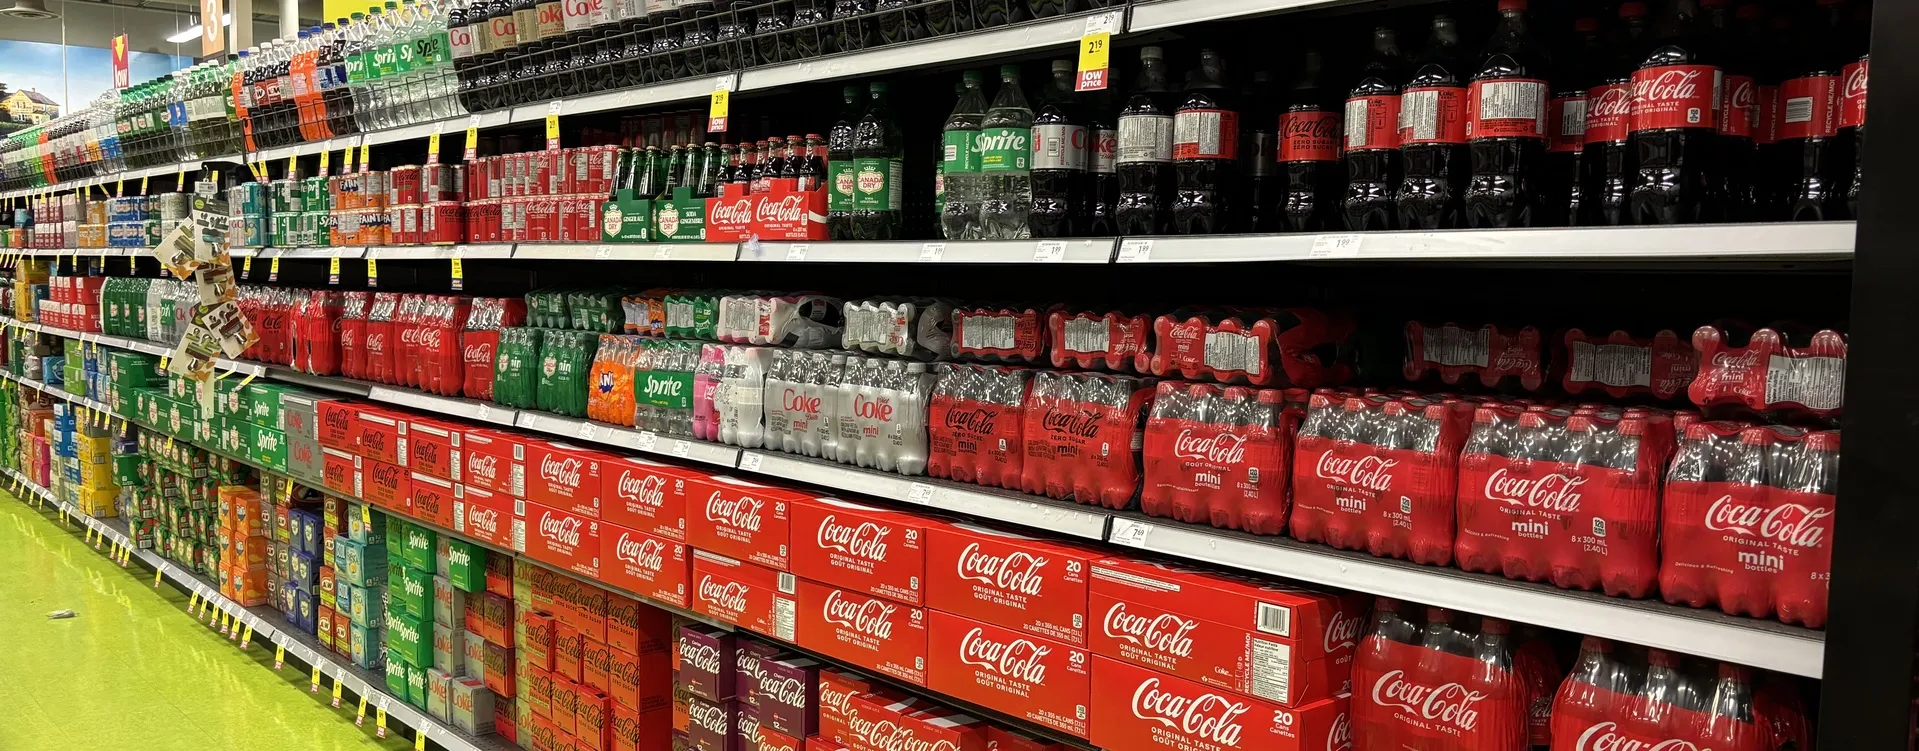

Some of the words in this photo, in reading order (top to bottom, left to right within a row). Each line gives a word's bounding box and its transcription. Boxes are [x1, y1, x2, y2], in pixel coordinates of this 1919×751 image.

[1080, 79, 1102, 90] price
[1082, 70, 1103, 81] low
[1828, 79, 1836, 105] ME/MOI
[711, 117, 725, 125] low
[1722, 103, 1730, 132] RECYCLE
[1825, 105, 1834, 134] RECYCLE
[710, 124, 724, 132] price
[971, 129, 1027, 156] Sprite
[755, 195, 804, 222] Coca-Cola
[604, 216, 622, 224] CANADA
[608, 223, 618, 231] DRY
[658, 216, 679, 224] CANADA
[663, 223, 674, 231] DRY
[643, 374, 682, 396] Sprite
[254, 400, 270, 417] Sprite
[782, 388, 822, 414] Coke
[854, 393, 893, 422] Coke
[945, 404, 1000, 435] Coca-Cola
[257, 429, 278, 452] Sprite
[1050, 434, 1067, 442] ZERO
[1068, 436, 1087, 446] SUGAR
[1174, 428, 1248, 464] Coca-Cola
[372, 457, 399, 490] Coca-Cola
[468, 451, 498, 479] Coca-Cola
[540, 453, 583, 488] Coca-Cola
[590, 461, 599, 471] 20
[1204, 462, 1232, 472] ORIGINAL
[1316, 449, 1401, 491] Coca-Cola
[675, 479, 684, 490] 20
[1195, 470, 1221, 485] mini
[617, 469, 667, 508] Coca-Cola
[1326, 483, 1357, 493] ORIGINAL
[1358, 488, 1377, 498] TASTE
[1485, 468, 1590, 512] Coca-Cola
[705, 490, 765, 533] Coca-Cola
[775, 501, 786, 512] 20
[1336, 495, 1367, 511] mini
[468, 504, 498, 533] Coca-Cola
[1391, 512, 1403, 520] 300
[1403, 513, 1412, 522] mL
[1499, 506, 1537, 516] ORIGINAL
[1538, 510, 1562, 521] TASTE
[1705, 494, 1835, 548] Coca-Cola
[540, 510, 583, 549] Coca-Cola
[589, 521, 599, 531] 20
[715, 524, 738, 535] ORIGINAL
[737, 529, 752, 539] TASTE
[905, 528, 918, 540] 20
[1511, 518, 1549, 536] mini
[1517, 531, 1544, 540] bottles
[409, 530, 429, 550] Sprite
[729, 533, 752, 544] ORIGINAL
[817, 514, 893, 562] Coca-Cola
[1571, 535, 1577, 543] 8
[1582, 536, 1596, 545] 300
[1596, 538, 1608, 547] mL
[1722, 534, 1770, 548] ORIGINAL
[1772, 541, 1800, 557] TASTE
[449, 545, 471, 567] Sprite
[616, 532, 666, 572] Coca-Cola
[673, 545, 684, 556] 20
[829, 552, 856, 564] ORIGINAL
[857, 559, 875, 568] TASTE
[1583, 544, 1600, 554] (2.40
[1600, 546, 1608, 556] L)
[957, 542, 1050, 597] Coca-Cola
[1066, 559, 1082, 573] 20
[1674, 561, 1699, 569] Delicious
[1737, 550, 1785, 571] mini
[1744, 563, 1778, 574] bottles
[1810, 572, 1817, 580] 8
[404, 576, 424, 598] Sprite
[699, 574, 750, 614] Coca-Cola
[972, 584, 1005, 598] ORIGINAL
[1005, 592, 1028, 603] TASTE
[973, 591, 992, 601] GOÛT
[993, 596, 1026, 610] ORIGINAL
[823, 589, 898, 640] Coca-Cola
[910, 608, 923, 620] 20
[399, 622, 420, 644] Sprite
[835, 627, 862, 640] ORIGINAL
[862, 635, 880, 646] TASTE
[1103, 602, 1200, 659] Coca-Cola
[960, 627, 1053, 686] Coca-Cola
[1069, 650, 1085, 664] 20
[1119, 643, 1153, 658] ORIGINAL
[1154, 653, 1178, 665] TASTE
[1120, 650, 1140, 662] GOÛT
[1141, 656, 1176, 671] ORIGINAL
[386, 657, 405, 679] Sprite
[407, 667, 426, 690] Sprite
[975, 670, 1007, 685] ORIGINAL
[1008, 679, 1031, 692] TASTE
[976, 677, 994, 689] GOÛT
[996, 683, 1030, 698] ORIGINAL
[1372, 669, 1489, 732] Coca-Cola
[1131, 677, 1252, 748] Coca-Cola
[1272, 709, 1294, 726] 20
[1269, 727, 1296, 739] Canettes
[1275, 722, 1290, 732] Cans
[1393, 711, 1432, 731] ORIGINAL
[1435, 723, 1462, 738] TASTE
